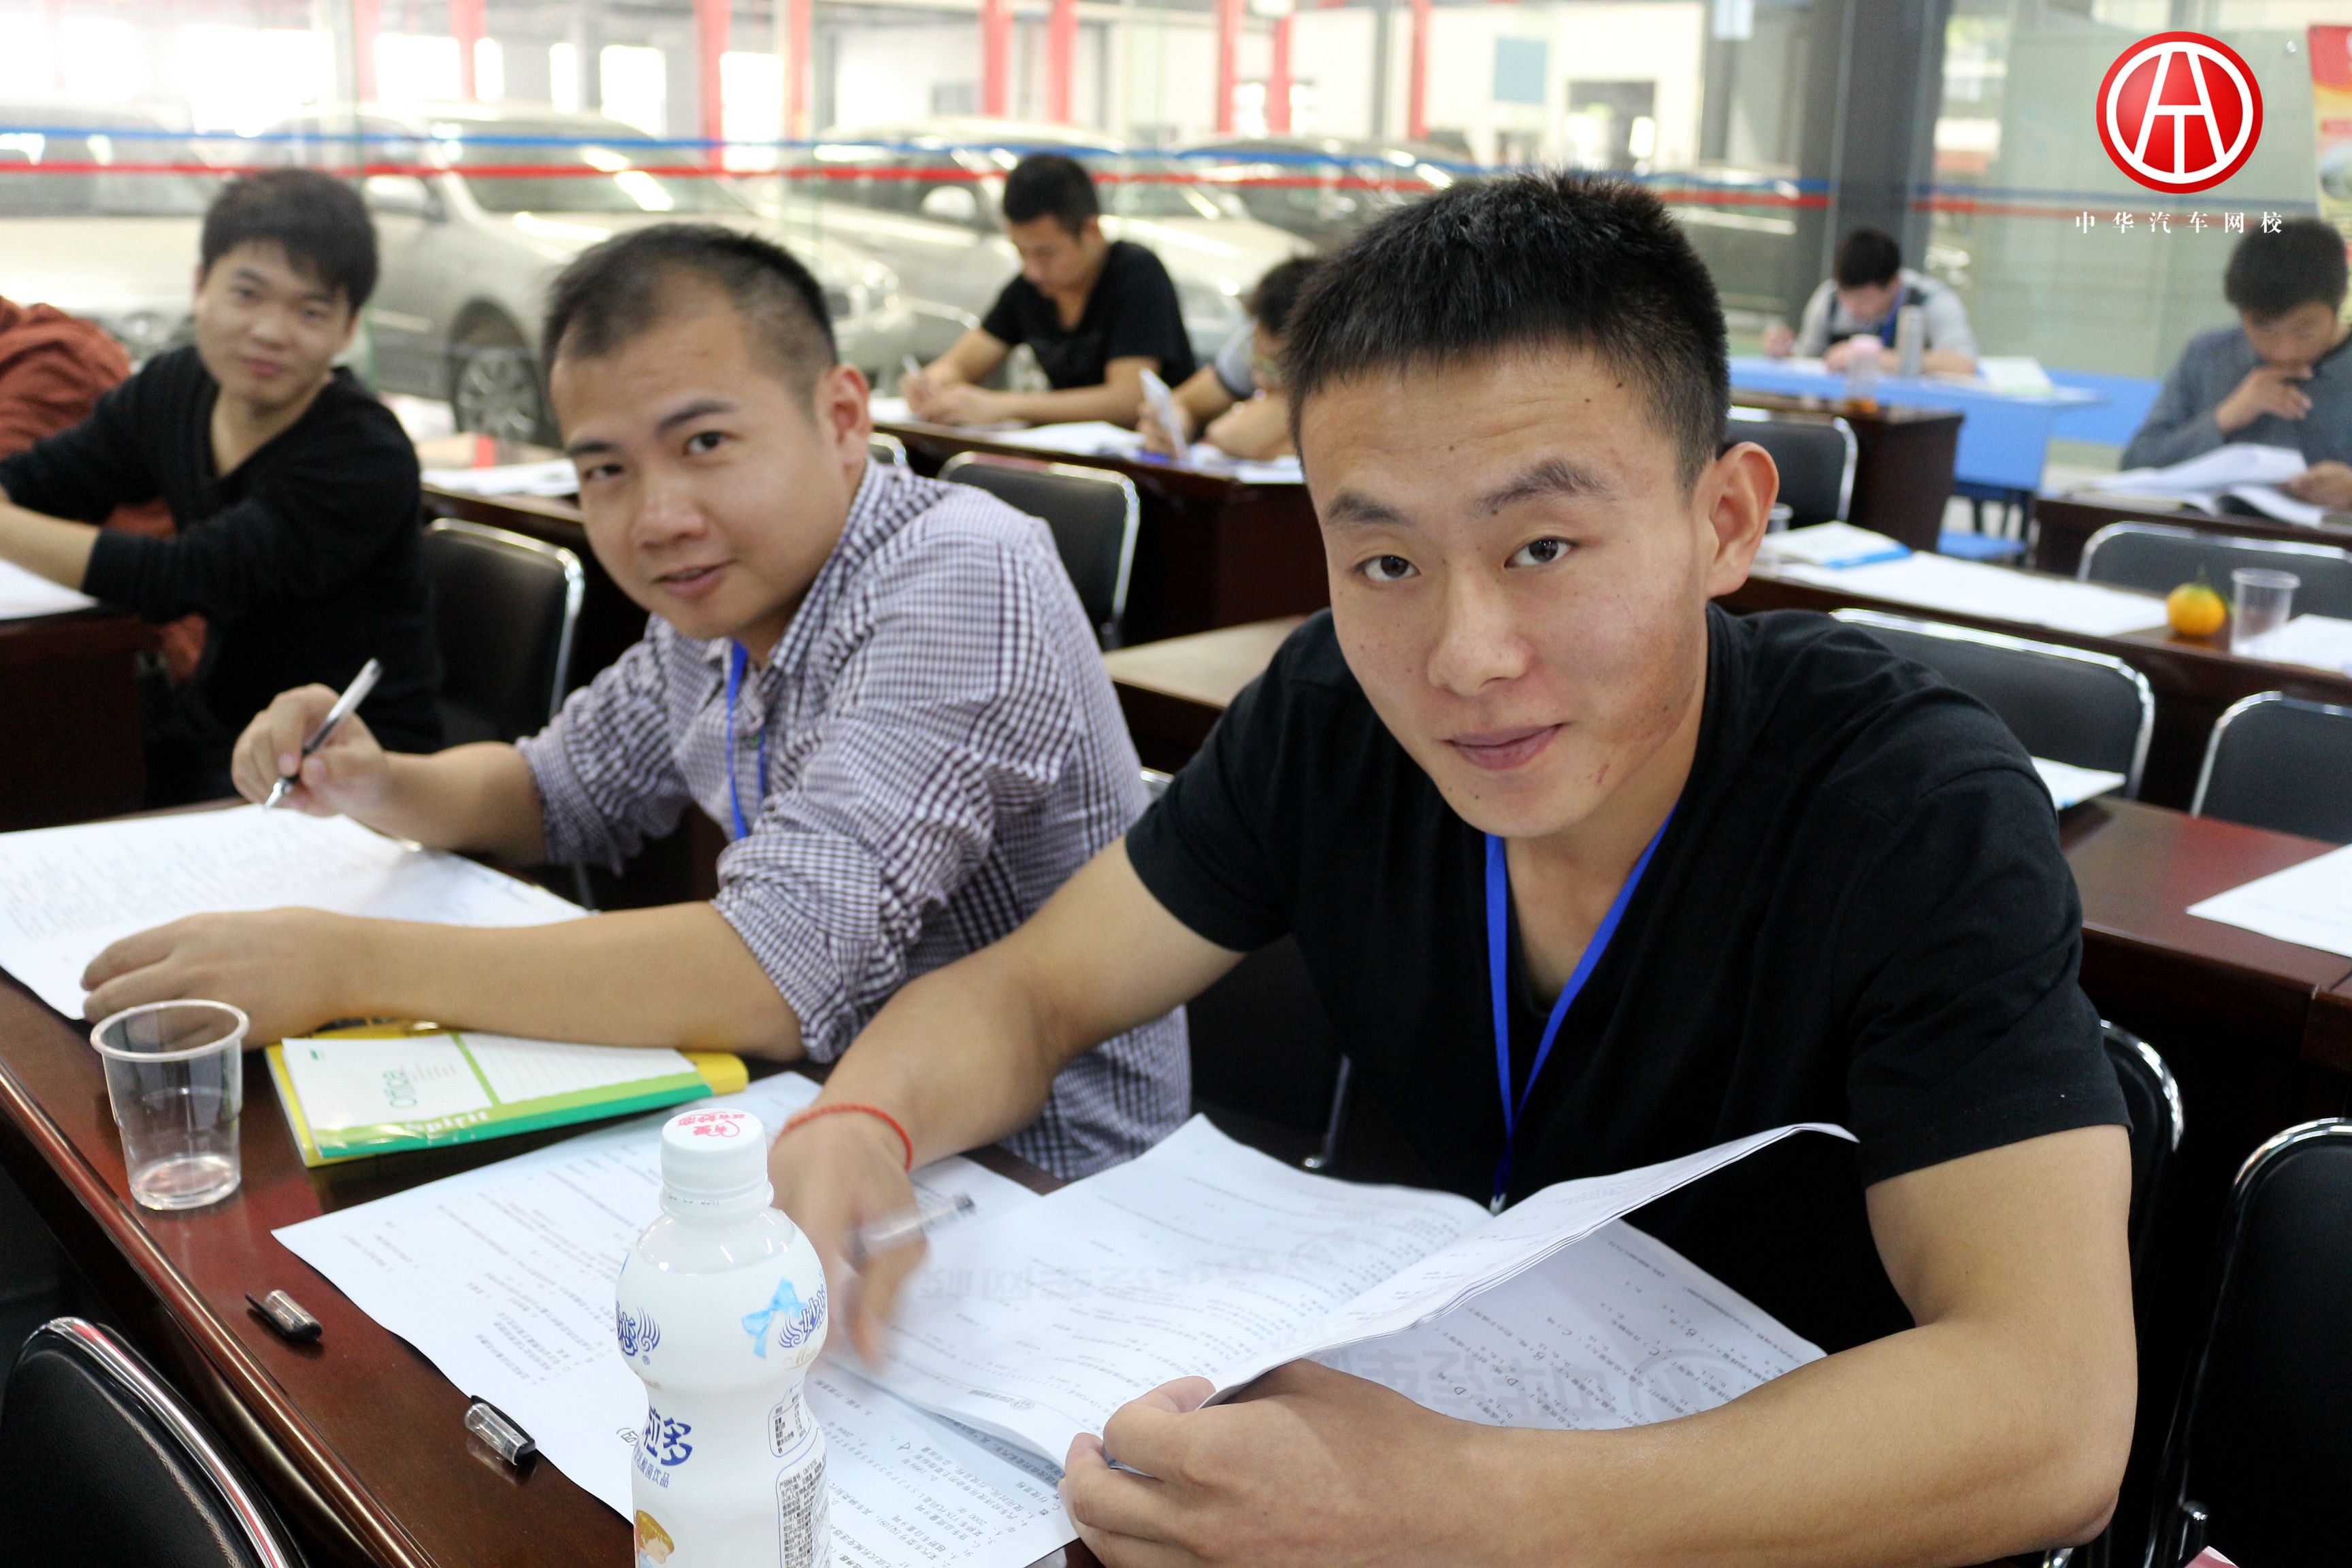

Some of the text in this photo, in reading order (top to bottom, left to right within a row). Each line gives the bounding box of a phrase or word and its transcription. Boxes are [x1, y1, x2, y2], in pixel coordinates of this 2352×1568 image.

[1648, 1347, 1659, 1356] C
[1507, 1378, 1518, 1386] D
[1454, 1386, 1466, 1395] D
[897, 1442, 911, 1451] A
